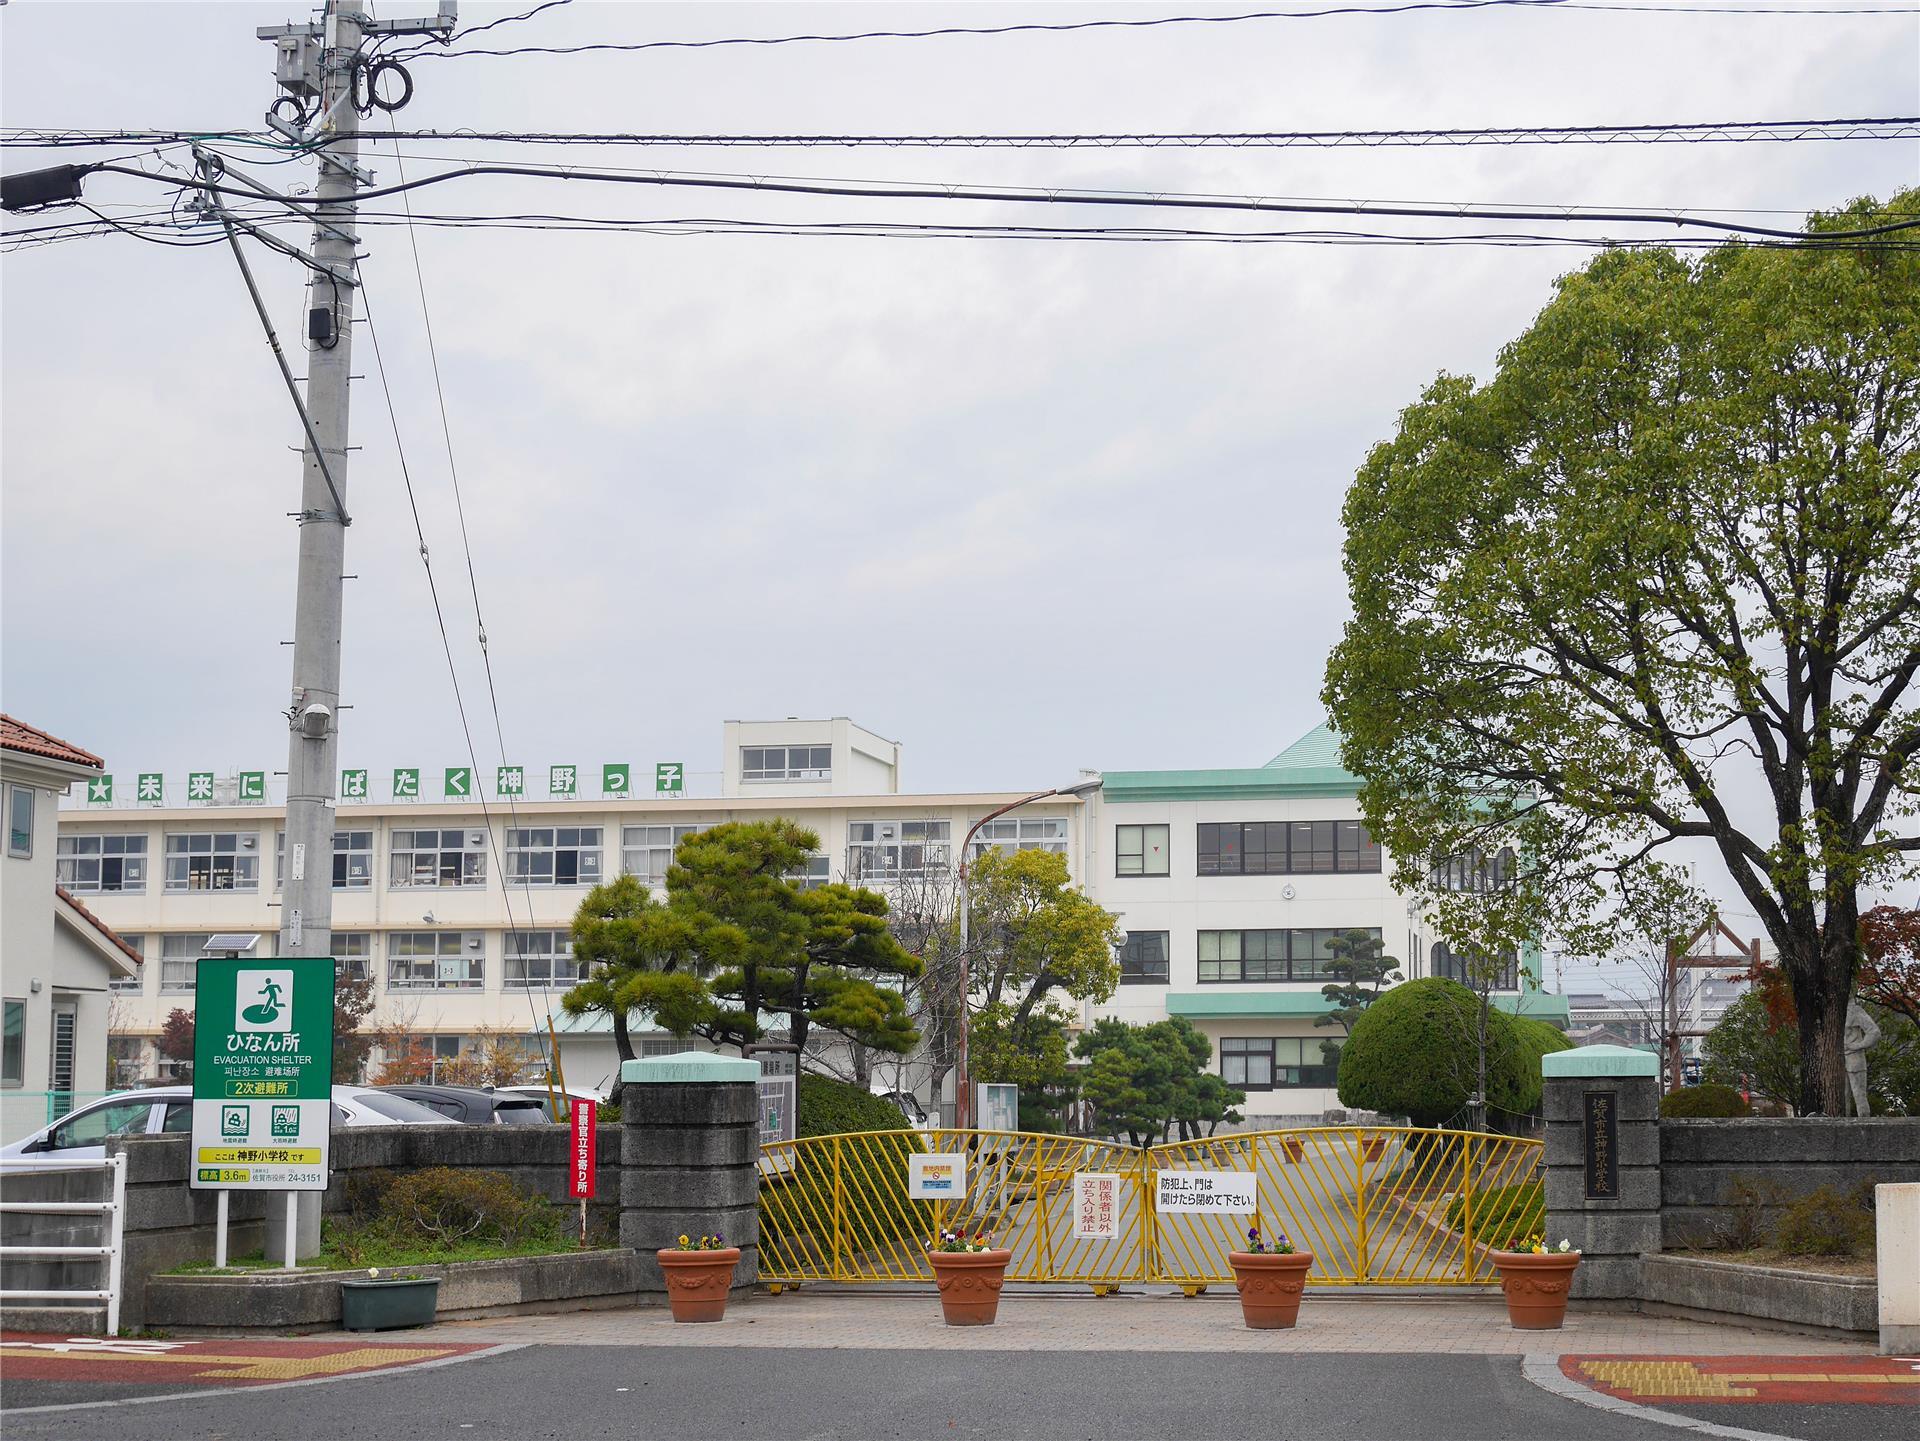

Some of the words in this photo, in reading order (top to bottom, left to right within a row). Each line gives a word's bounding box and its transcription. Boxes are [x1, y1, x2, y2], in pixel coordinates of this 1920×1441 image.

[140, 765, 681, 799] 未来にばたく神野っ子
[226, 1033, 300, 1053] ひなん所
[213, 1055, 270, 1065] EVACUATION
[271, 1055, 312, 1064] SHELTER
[224, 1066, 260, 1077] 피난장소
[235, 1082, 288, 1095] 2次避難所
[577, 1103, 589, 1193] 警察官立ち寄り所
[215, 1153, 235, 1161] ここは
[237, 1150, 289, 1162] 神野小学校
[291, 1153, 305, 1162] です
[224, 1170, 247, 1181] 3.6m
[252, 1174, 286, 1183] 佐賀市役所
[288, 1173, 321, 1183] 24-3151
[1160, 1177, 1213, 1191] 防犯上、門は
[1081, 1179, 1096, 1232] 立ち入り禁止
[1098, 1180, 1113, 1233] 関係者以外
[1160, 1192, 1255, 1207] 開けたら閉めて下さい。
